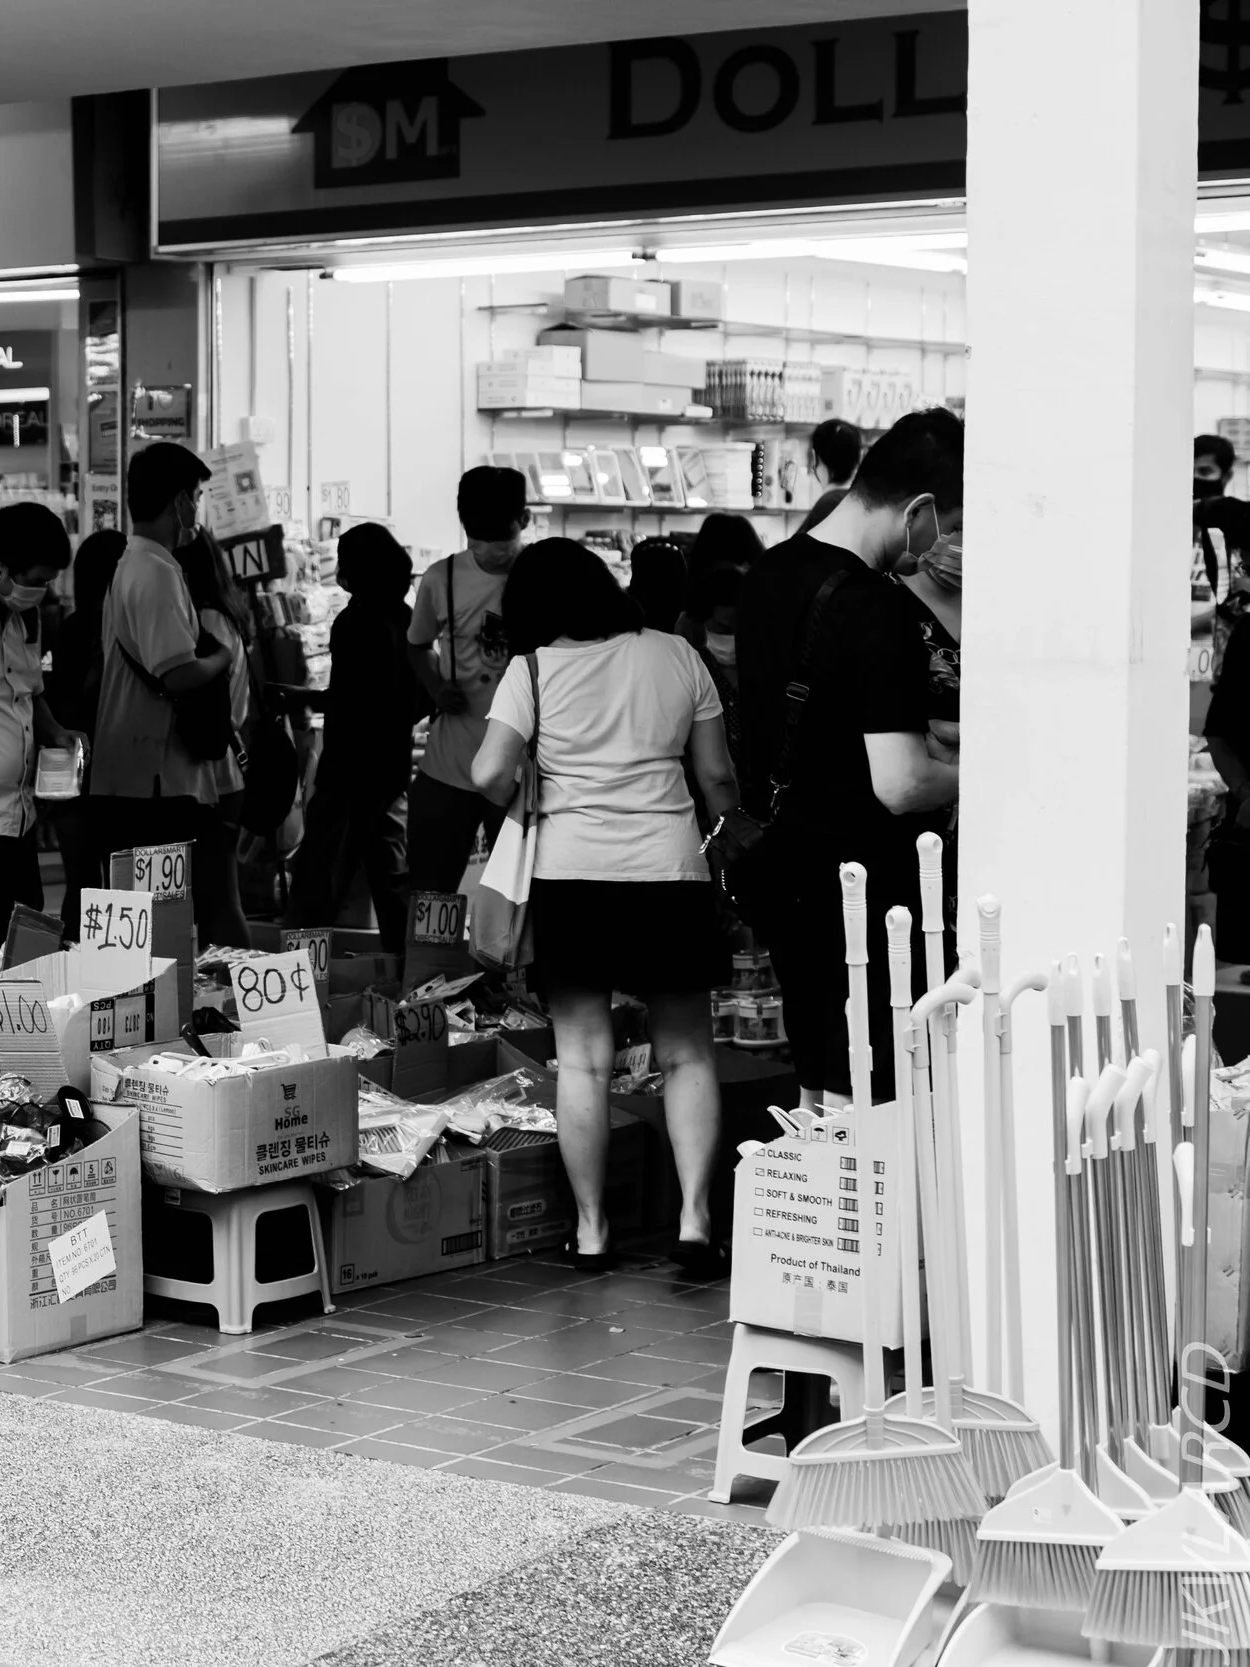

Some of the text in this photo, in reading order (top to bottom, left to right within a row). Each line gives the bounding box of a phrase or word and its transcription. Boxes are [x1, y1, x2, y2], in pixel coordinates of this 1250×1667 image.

[135, 854, 185, 892] $1.90
[416, 902, 459, 936] $1.00
[93, 1040, 111, 1050] QTY
[284, 1105, 300, 1118] SG
[275, 1114, 309, 1131] Home
[256, 1131, 330, 1162] 클렌징 물티슈
[259, 1152, 326, 1175] SKINCARE WIPES
[767, 1149, 802, 1162] CLASSIC
[767, 1169, 808, 1183] RELAXING
[766, 1188, 833, 1207] SOFT & SMOOTH
[766, 1208, 818, 1225] REFRESHING
[70, 1228, 88, 1246] BTT
[796, 1233, 821, 1245] BRIGHTER
[822, 1238, 834, 1248] SKIN
[55, 1254, 72, 1269] ITEM
[770, 1253, 861, 1277] Product of Thailand
